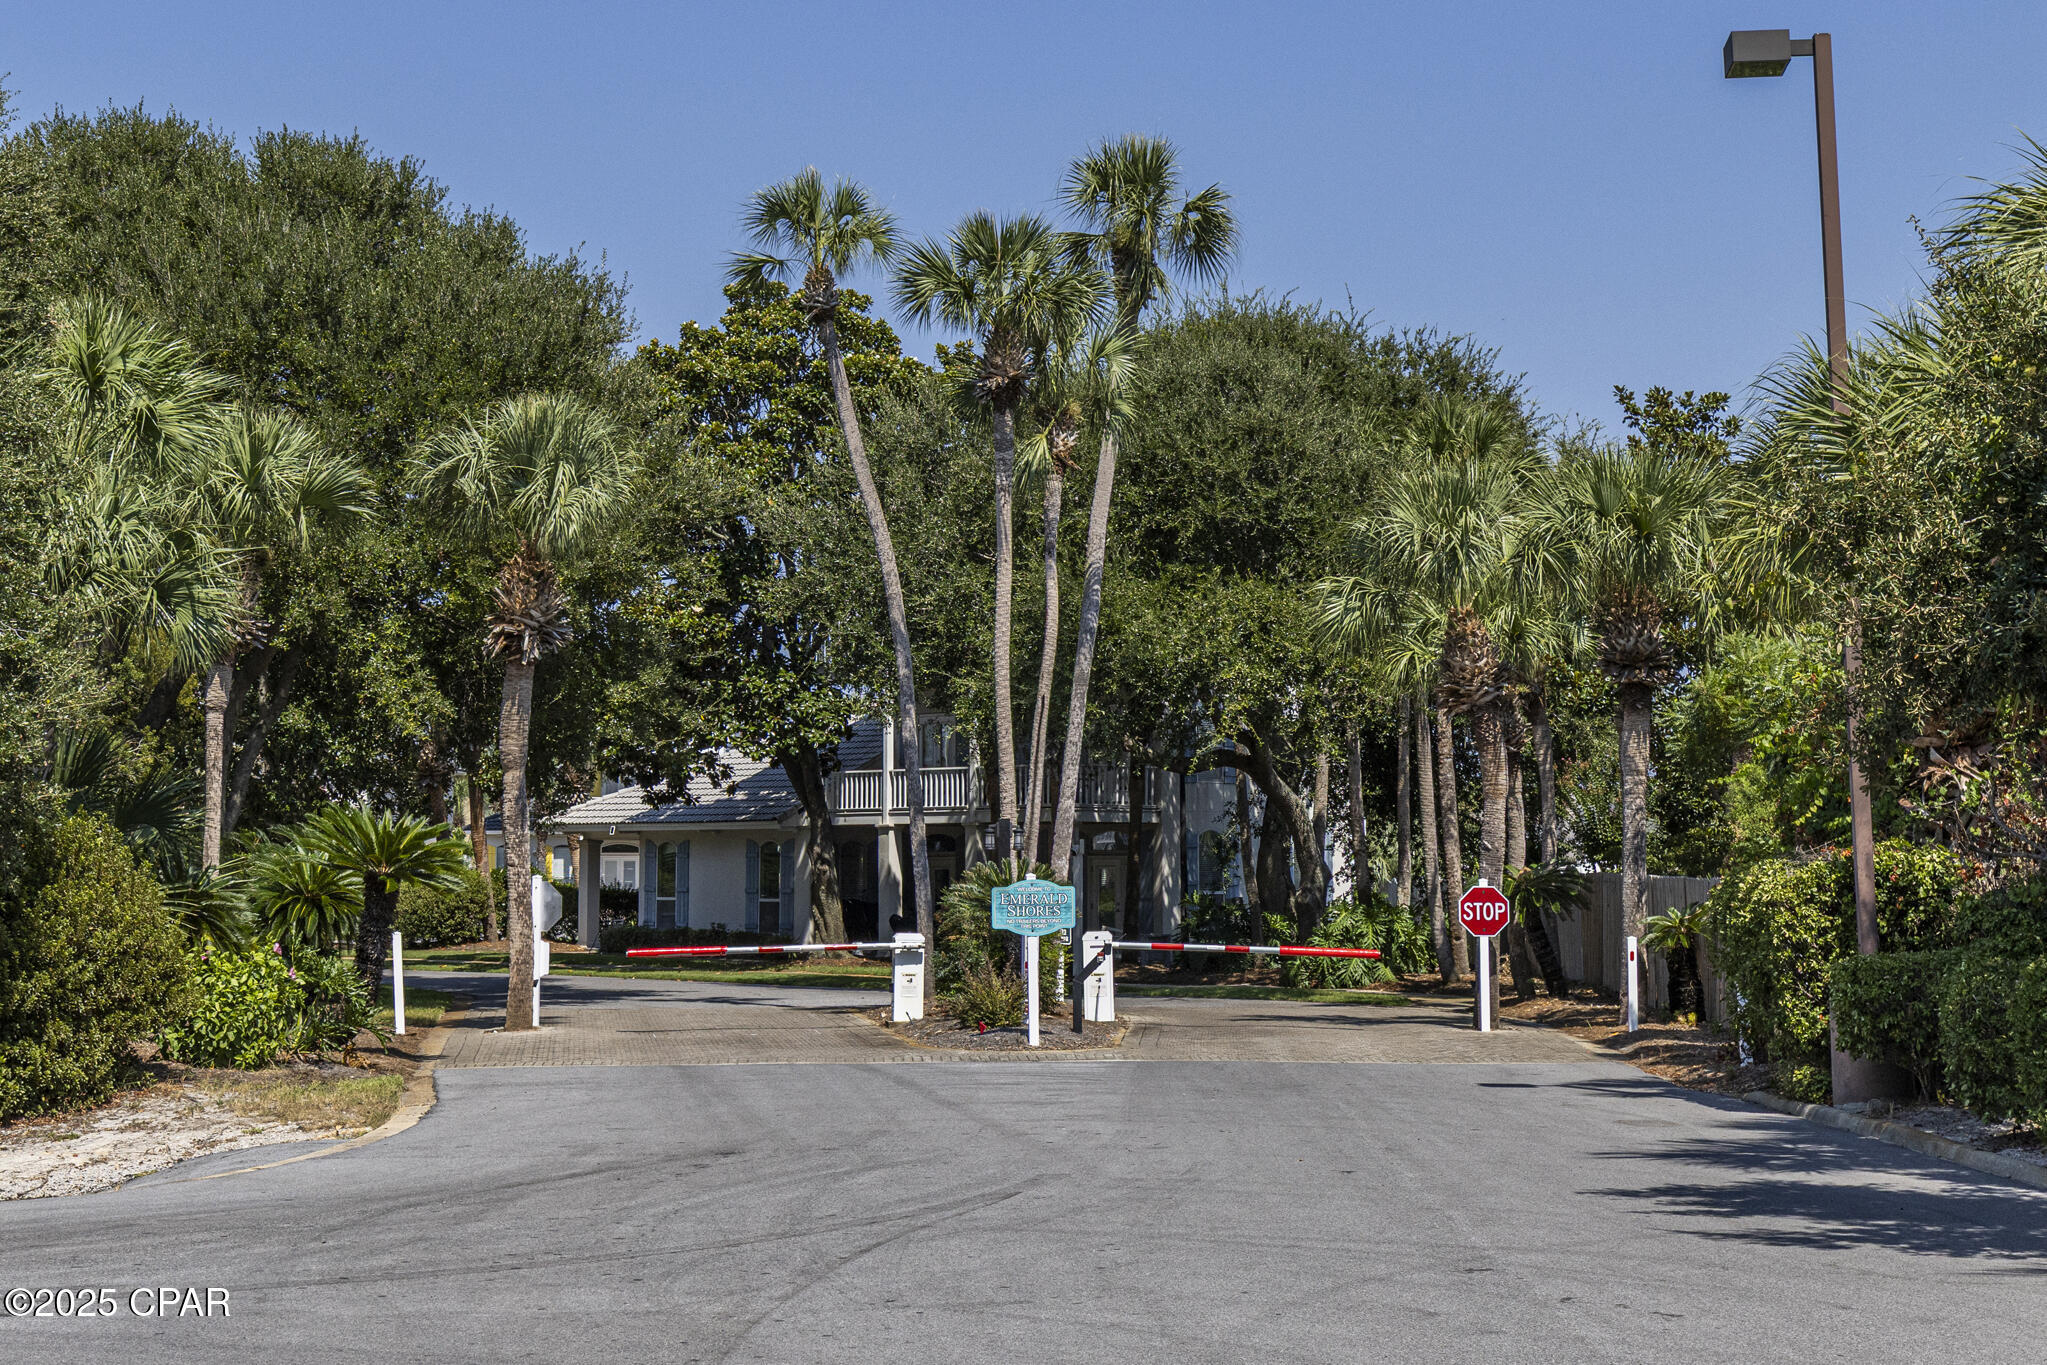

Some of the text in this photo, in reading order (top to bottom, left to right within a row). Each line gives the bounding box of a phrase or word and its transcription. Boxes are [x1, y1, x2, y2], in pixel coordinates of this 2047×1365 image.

[1000, 893, 1068, 905] EMERALD
[1007, 905, 1061, 917] SHORES
[1463, 902, 1506, 921] STOP
